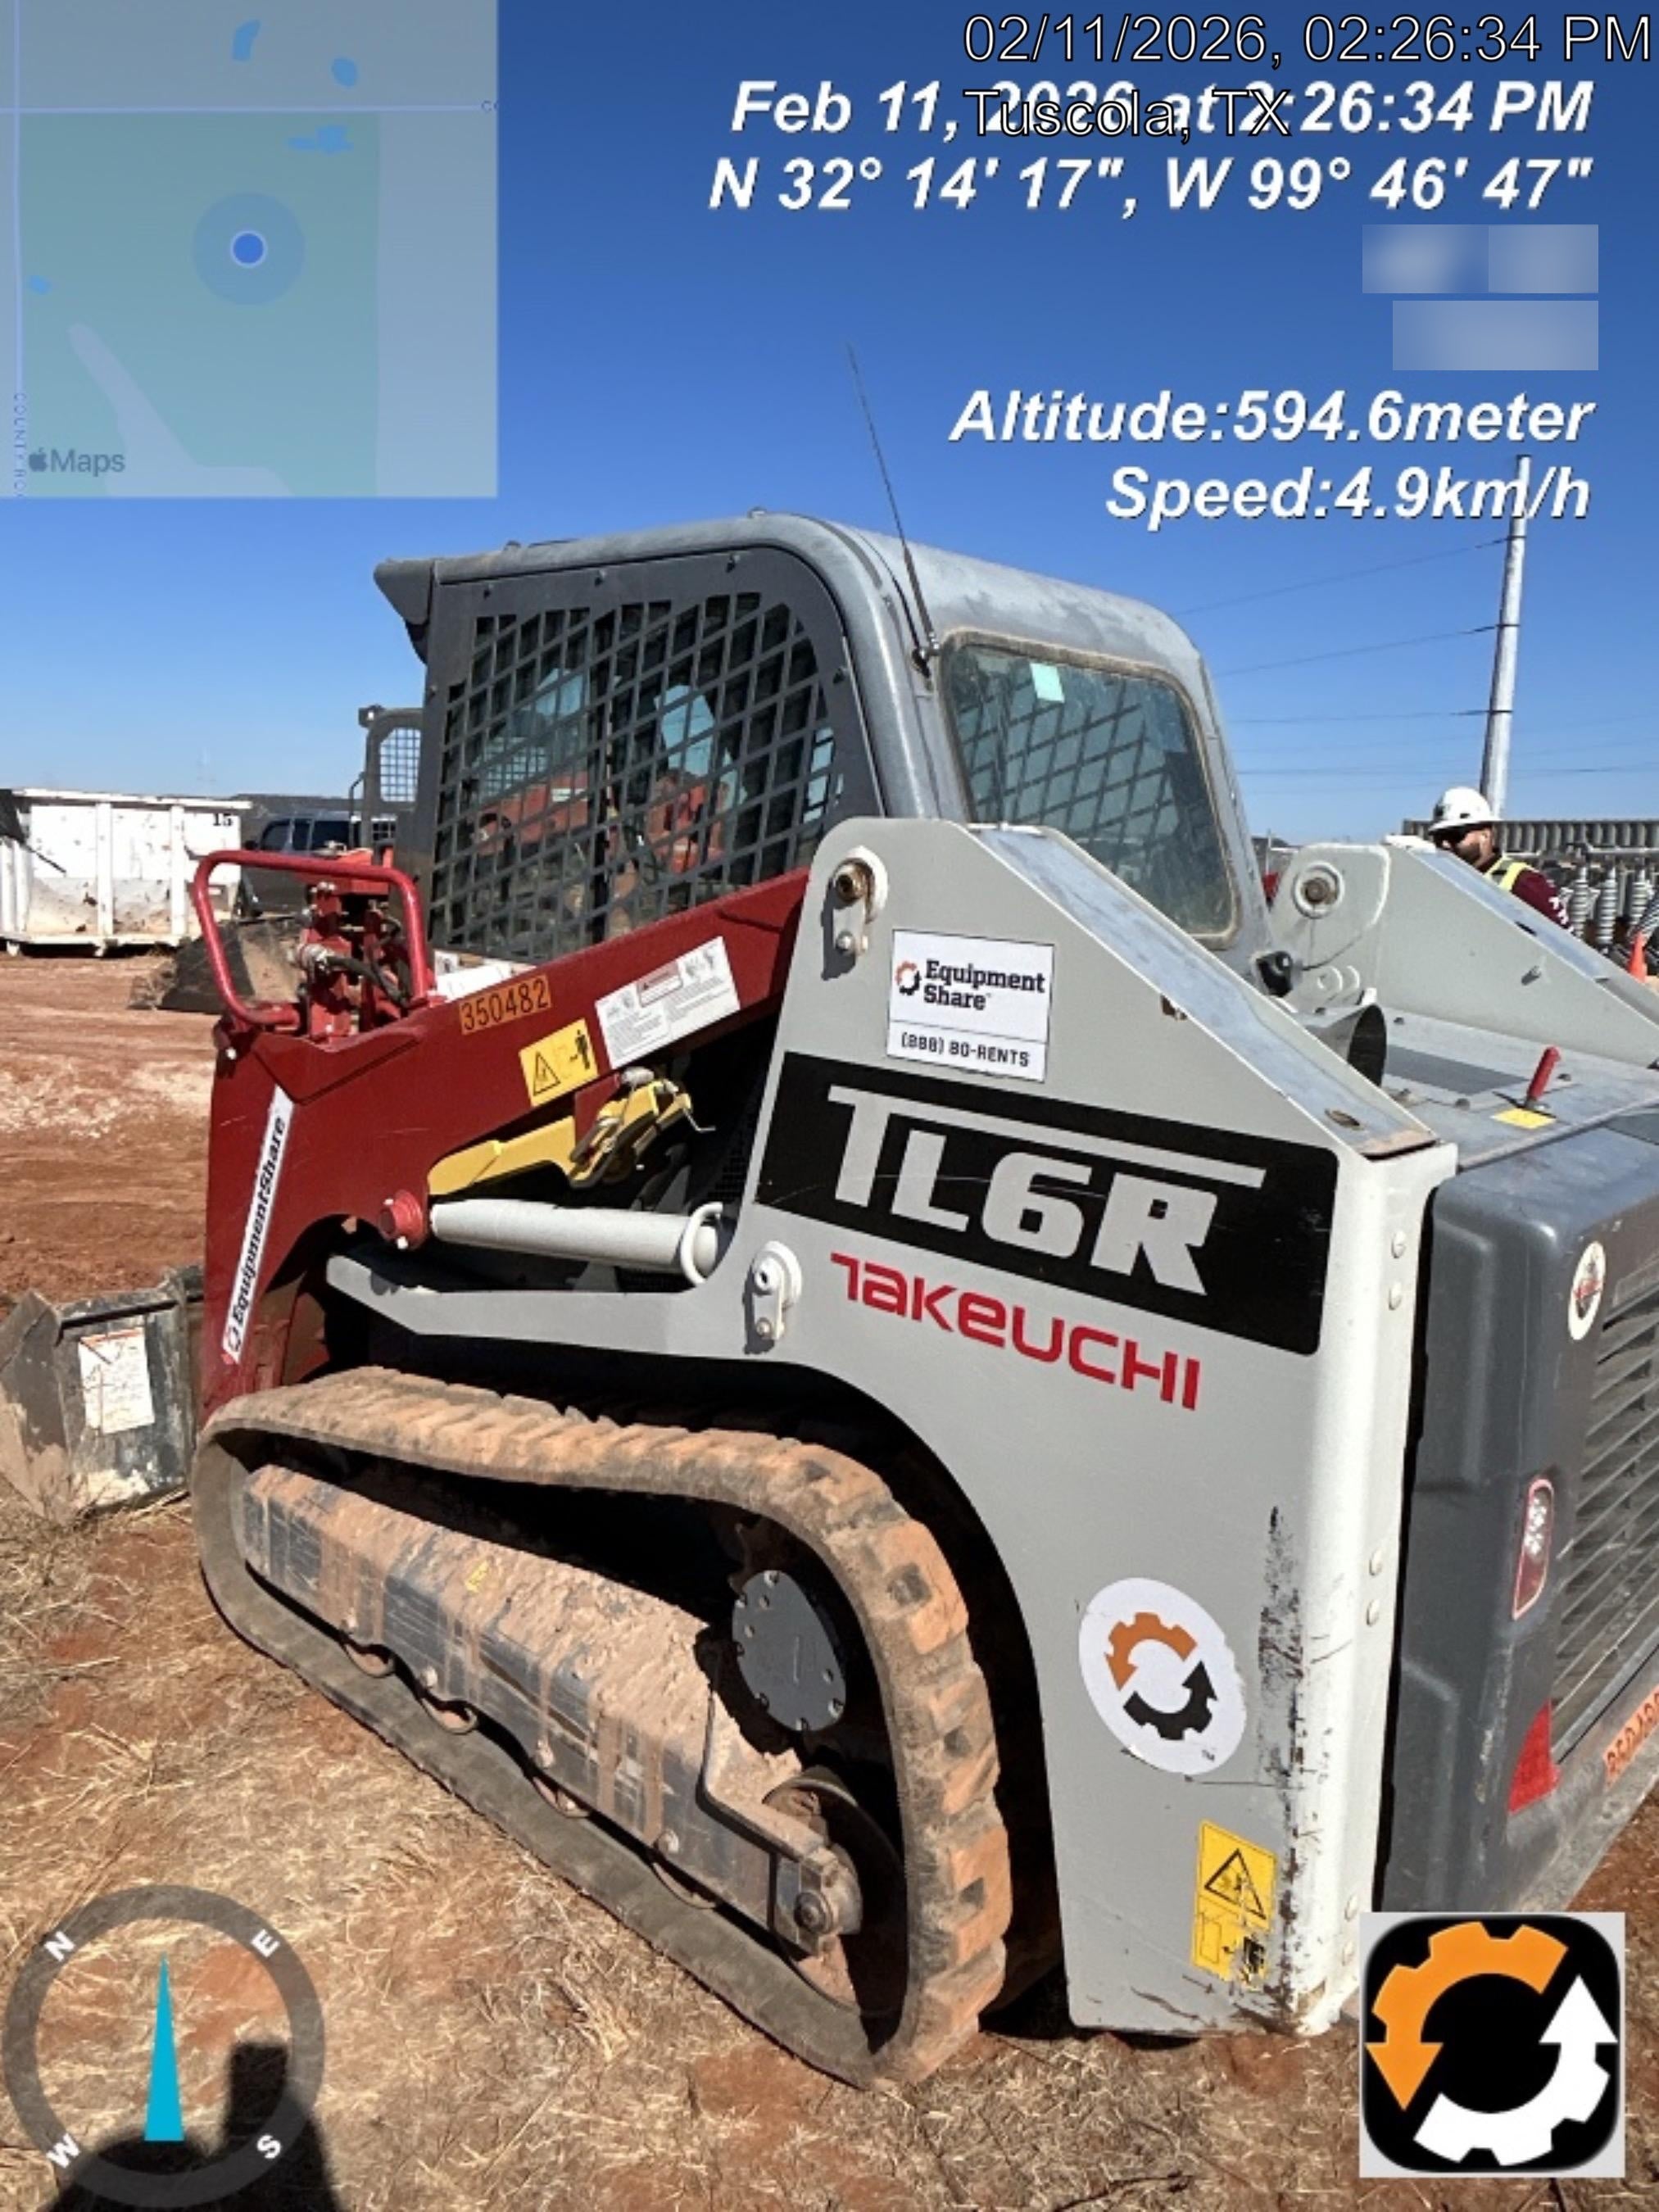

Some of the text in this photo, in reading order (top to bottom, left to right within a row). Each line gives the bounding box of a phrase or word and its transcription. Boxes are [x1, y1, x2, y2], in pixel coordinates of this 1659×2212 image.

[923, 983, 986, 1011] Share
[925, 959, 1045, 994] Equipment
[461, 978, 549, 1031] 350482
[827, 1086, 1267, 1296] TL6R
[233, 1117, 285, 1325] EquipmentShare
